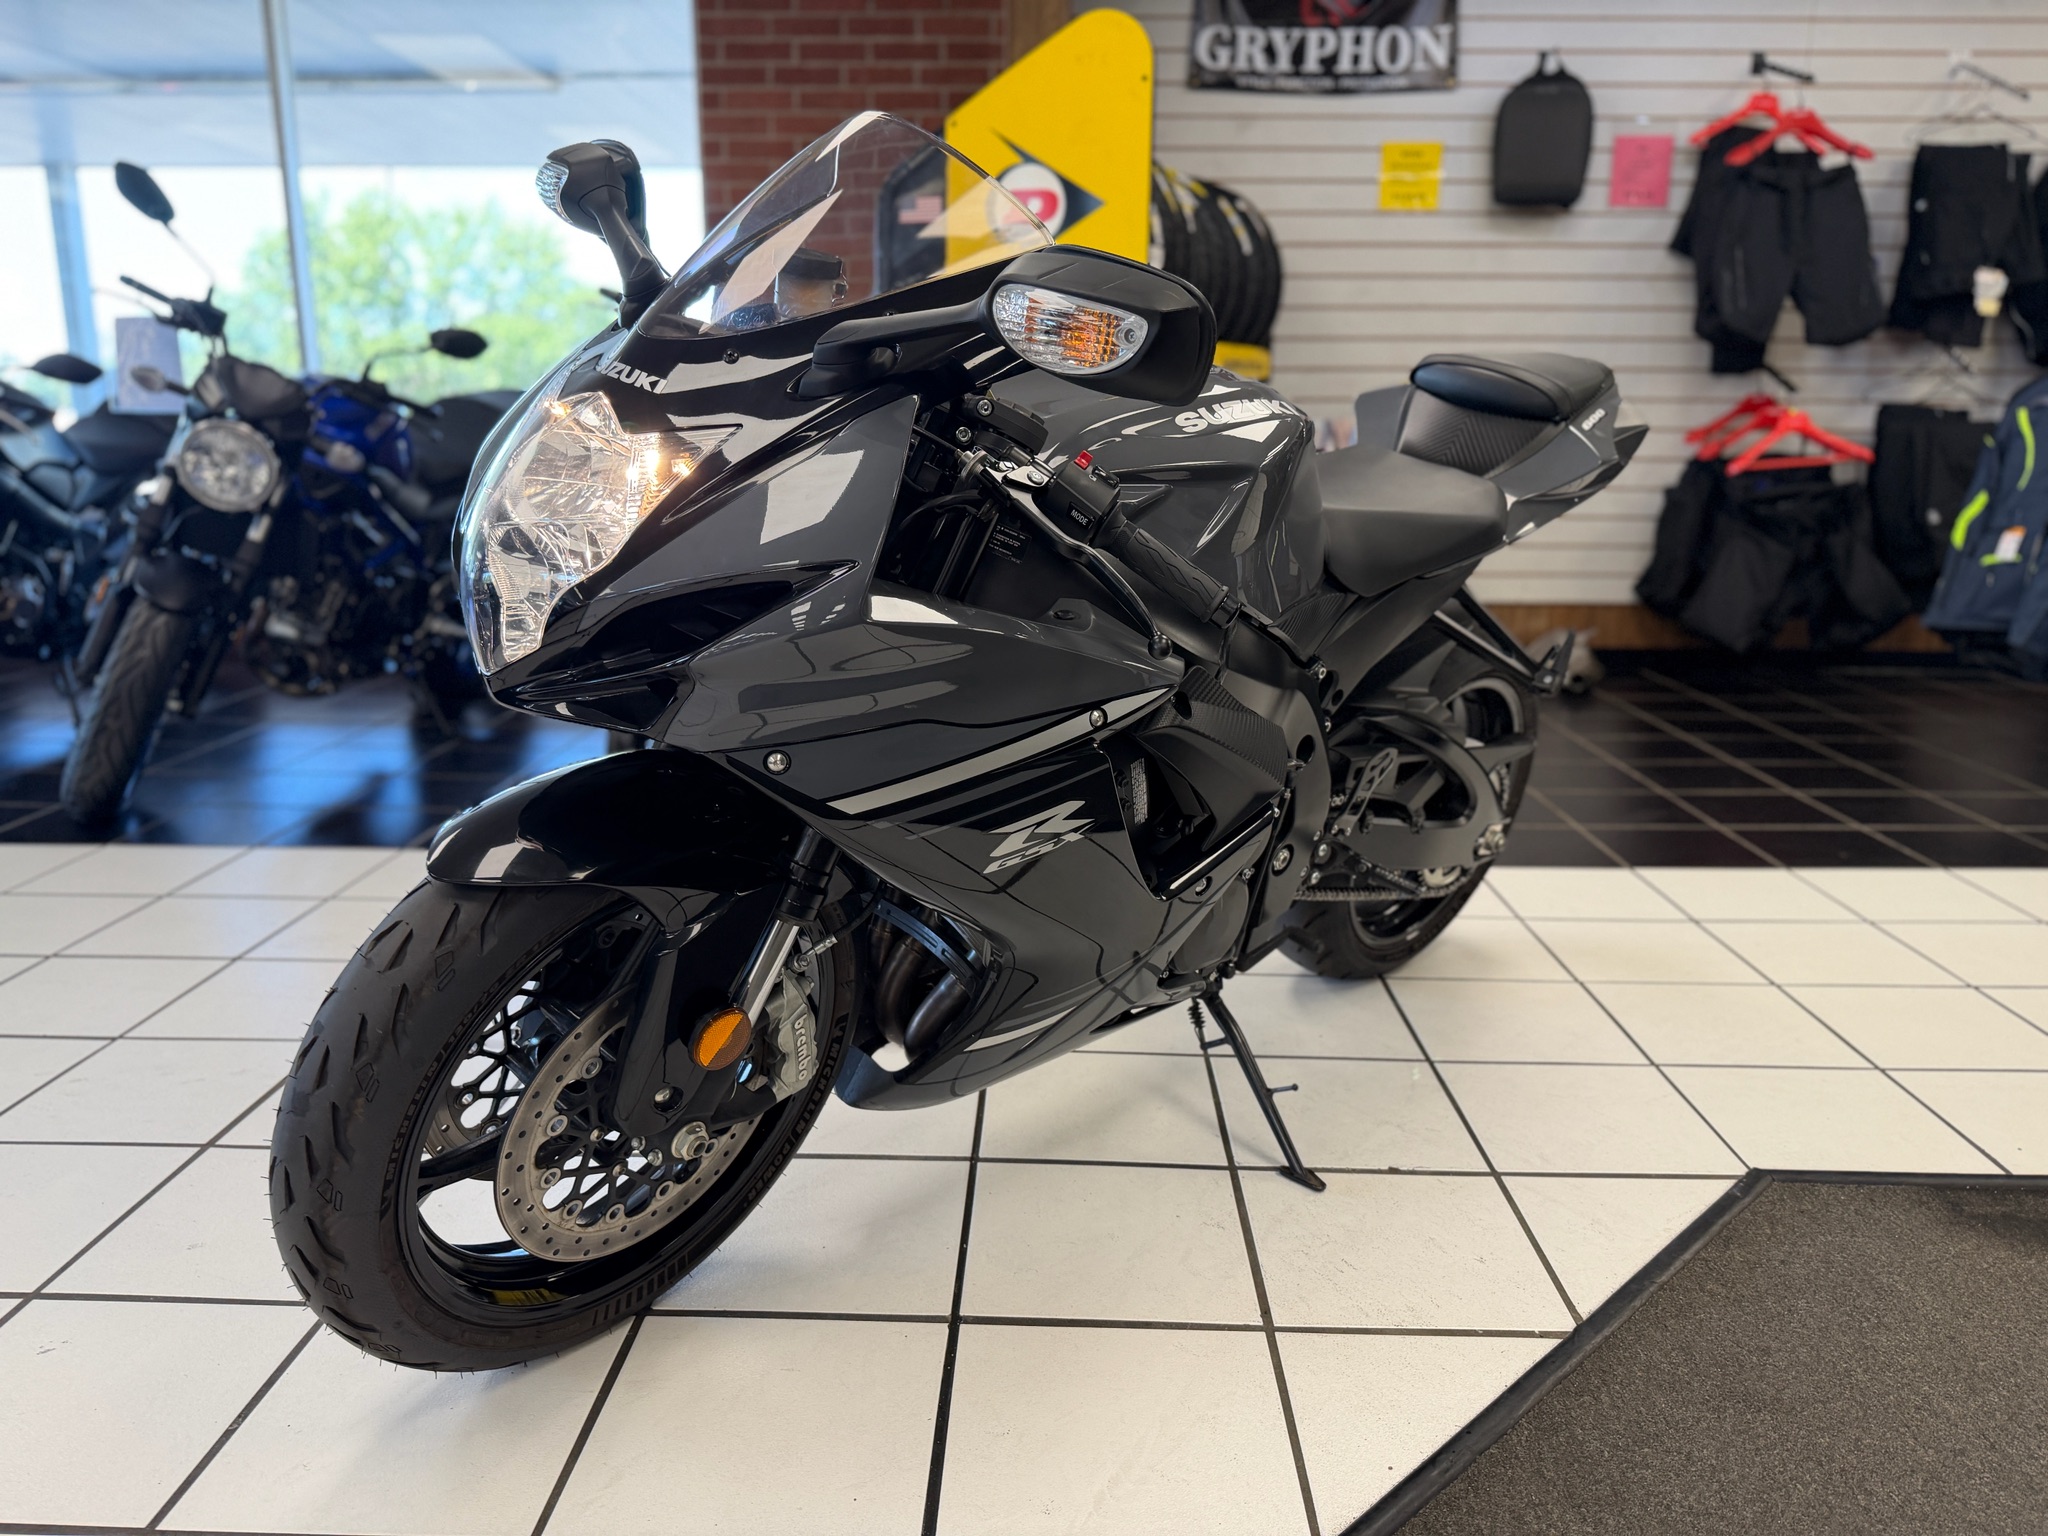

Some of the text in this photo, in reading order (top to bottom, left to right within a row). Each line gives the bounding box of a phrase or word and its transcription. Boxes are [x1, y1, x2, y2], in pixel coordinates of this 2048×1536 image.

[1194, 22, 1453, 75] GRYPHON
[1174, 397, 1300, 433] SUZUKI
[1070, 509, 1090, 526] MODE
[794, 1013, 812, 1081] brembo
[386, 1060, 438, 1181] MICHELIN
[747, 1042, 841, 1202] MICHELIN POWER
